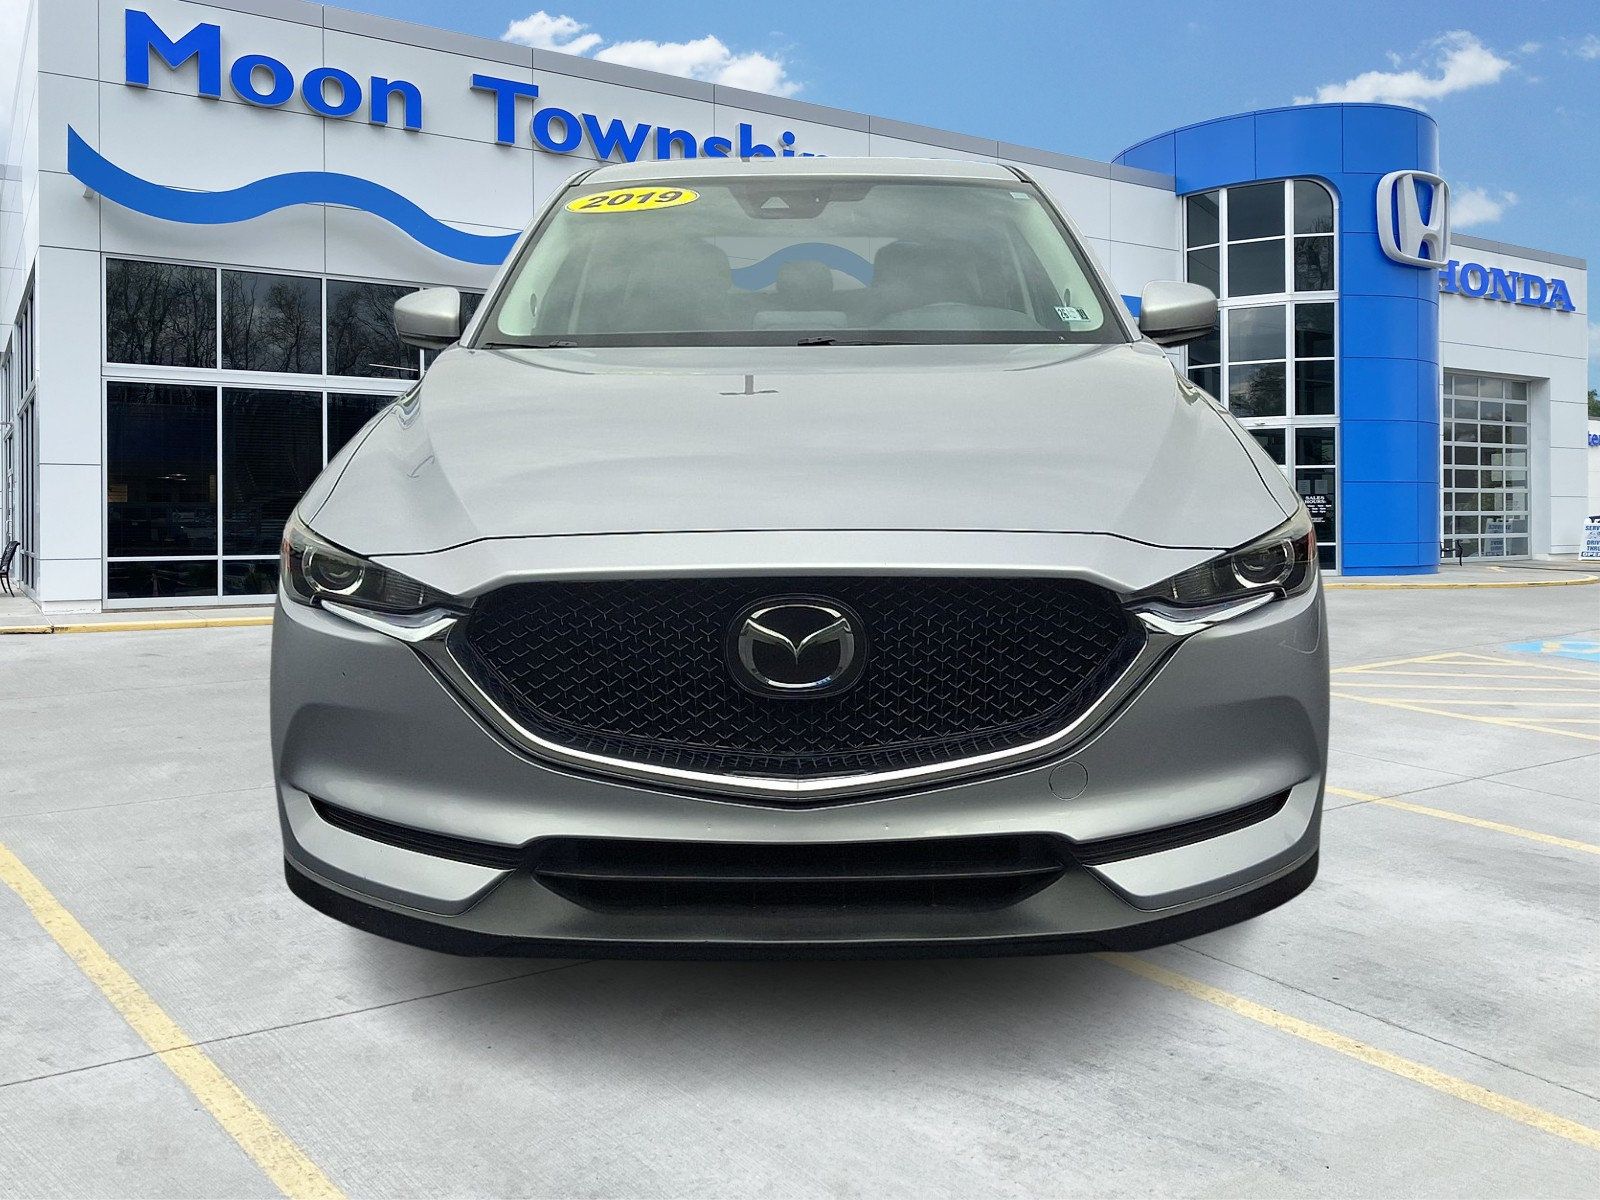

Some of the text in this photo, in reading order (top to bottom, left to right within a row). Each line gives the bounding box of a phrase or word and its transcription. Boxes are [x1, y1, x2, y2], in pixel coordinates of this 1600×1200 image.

[125, 9, 815, 163] Moon Townshi
[579, 190, 683, 210] 2019
